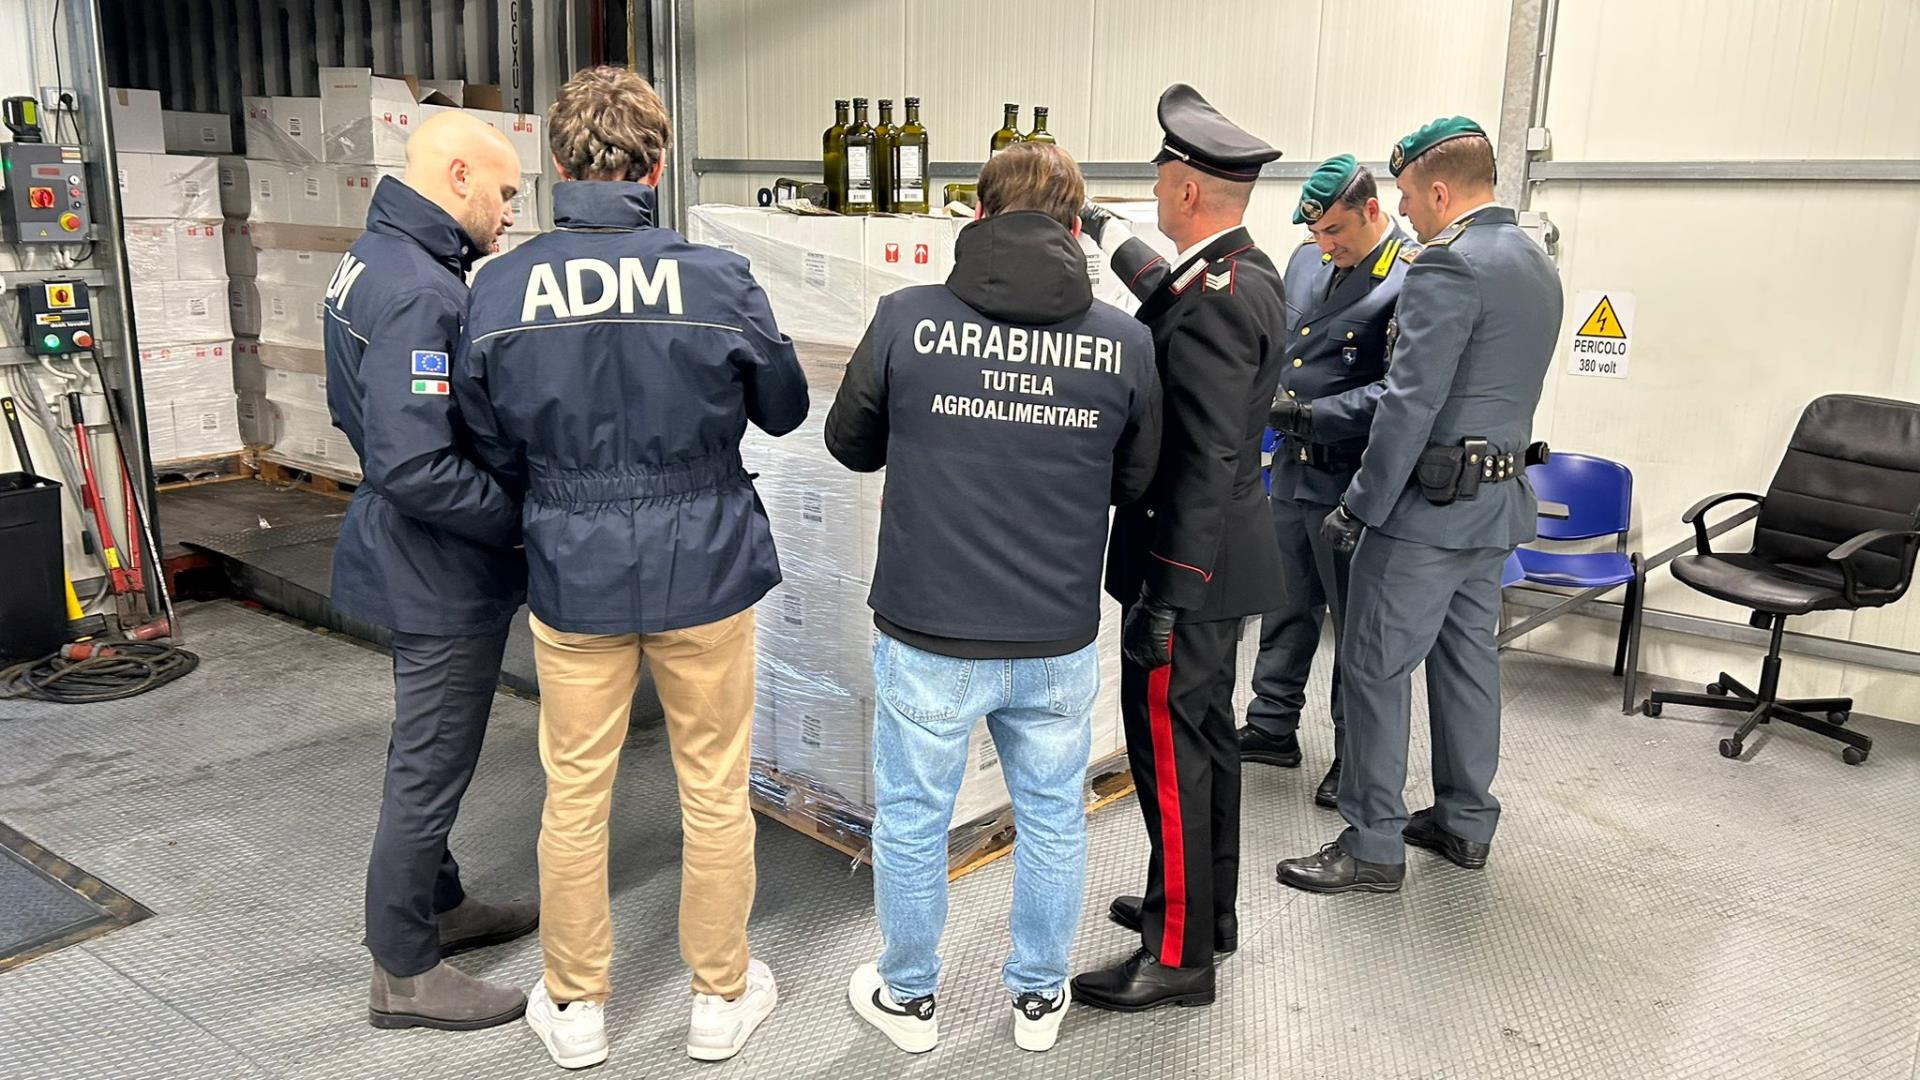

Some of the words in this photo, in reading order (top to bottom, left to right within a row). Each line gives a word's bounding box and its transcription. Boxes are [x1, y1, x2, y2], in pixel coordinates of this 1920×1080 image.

[511, 2, 519, 89] GCXU
[521, 257, 684, 322] ADM
[913, 319, 1122, 375] CARABINIERI
[1574, 339, 1626, 355] PERICOLO
[981, 370, 1054, 396] TUTELA
[1579, 358, 1596, 372] 380
[1598, 361, 1617, 374] volt
[931, 394, 1100, 429] AGROALIMENTARE
